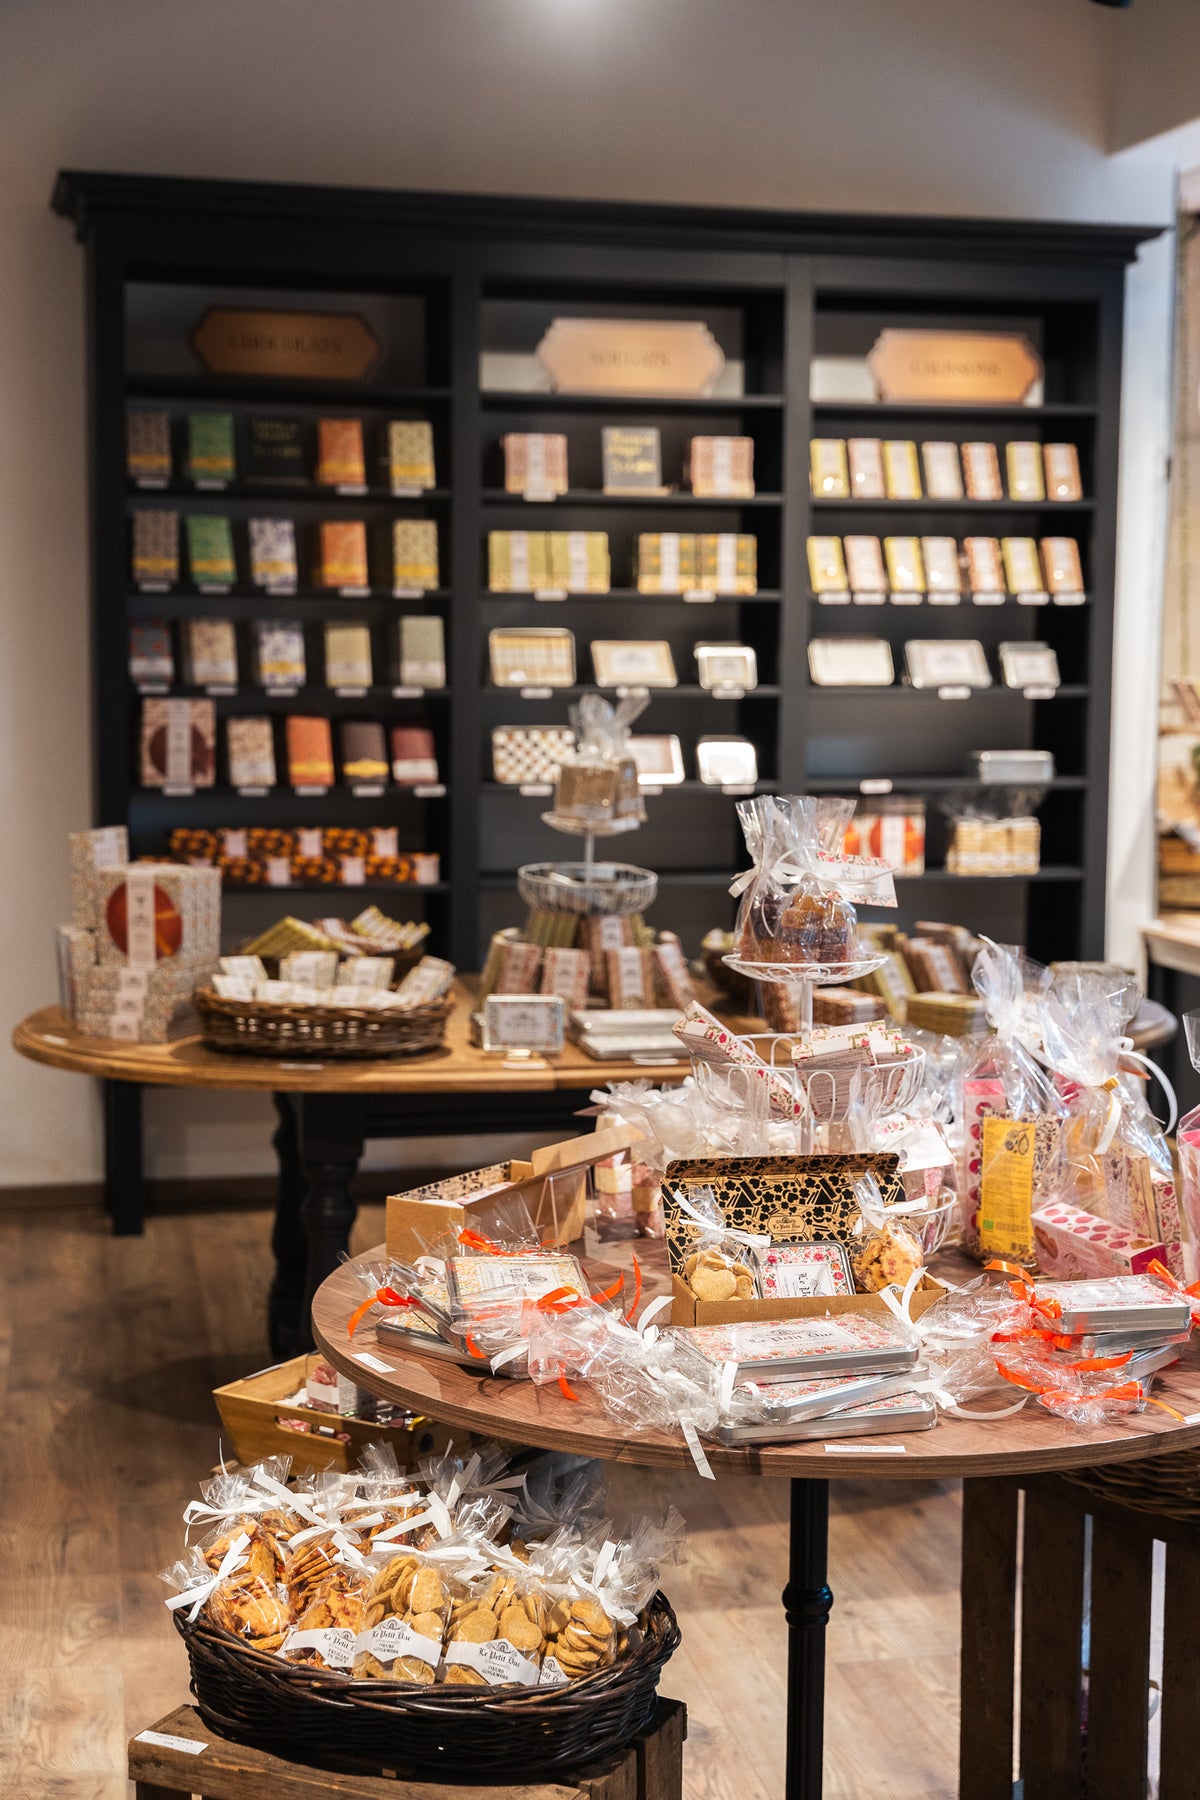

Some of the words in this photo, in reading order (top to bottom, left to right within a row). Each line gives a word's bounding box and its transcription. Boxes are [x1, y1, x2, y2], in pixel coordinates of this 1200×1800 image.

[323, 1633, 331, 1641] Le
[333, 1636, 349, 1649] Petit
[372, 1630, 379, 1638] Le
[380, 1630, 395, 1640] Petit
[398, 1632, 411, 1642] Duc
[479, 1647, 488, 1657] Le
[489, 1649, 506, 1662] Petit
[508, 1656, 521, 1668] Duc
